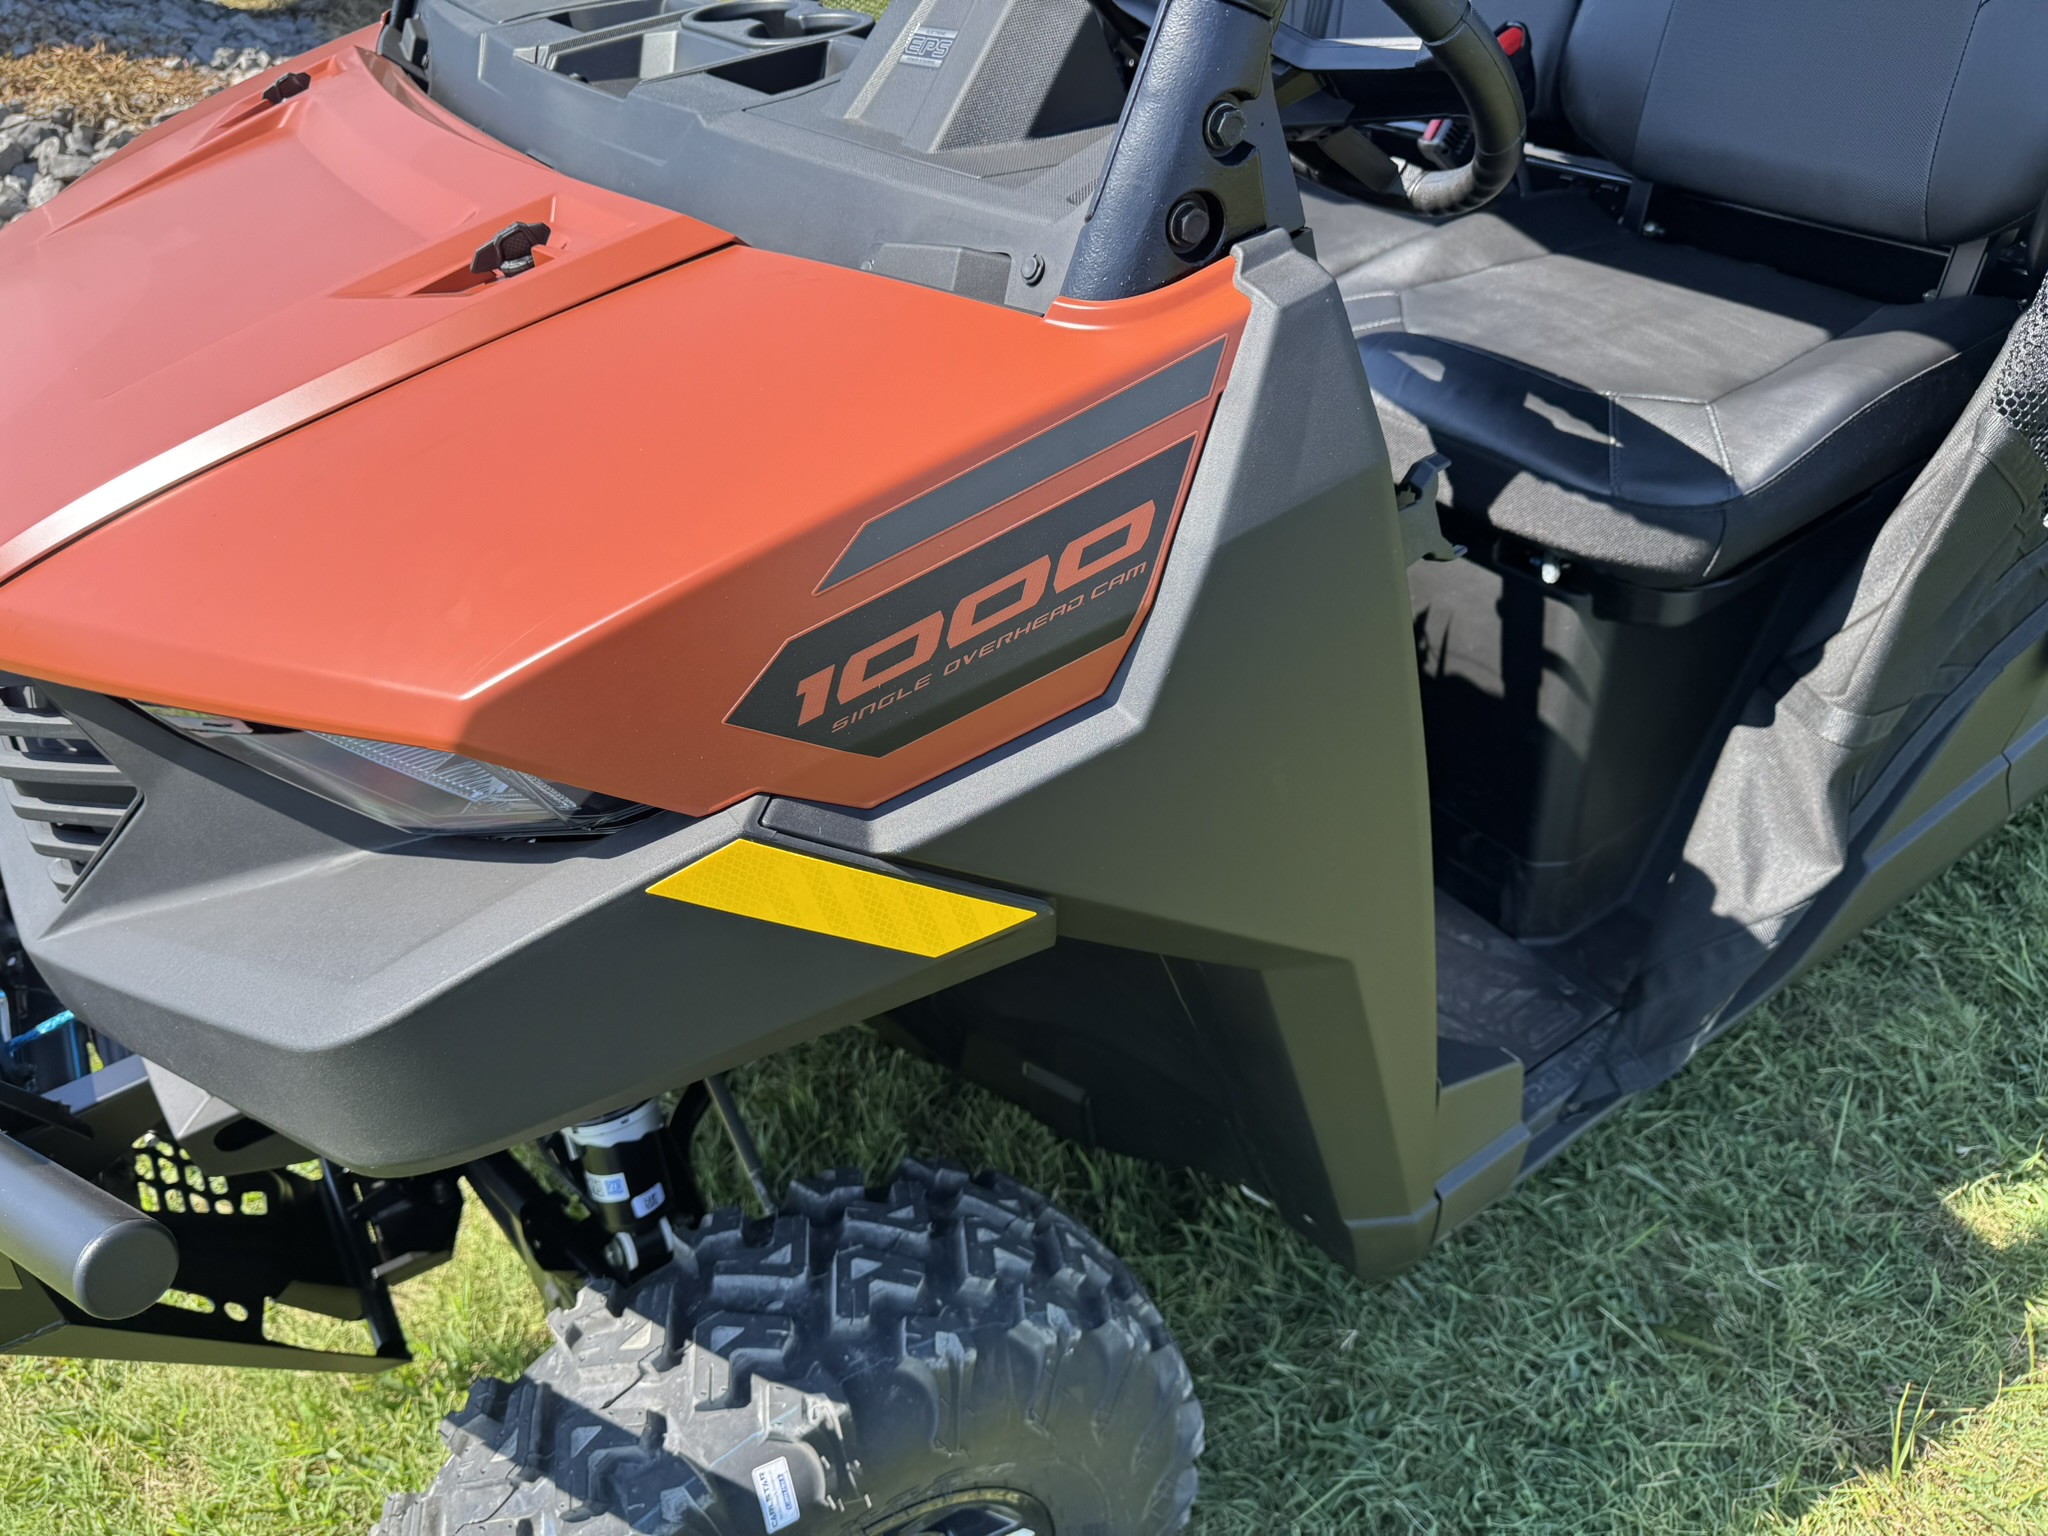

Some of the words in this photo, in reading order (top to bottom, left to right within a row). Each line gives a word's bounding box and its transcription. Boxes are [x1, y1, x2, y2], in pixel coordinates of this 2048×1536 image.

[905, 35, 953, 58] EPS
[796, 499, 1156, 728] 1000
[831, 673, 932, 733] SINGLE
[943, 594, 1085, 677] OVERHEAD
[1091, 561, 1147, 600] CAM
